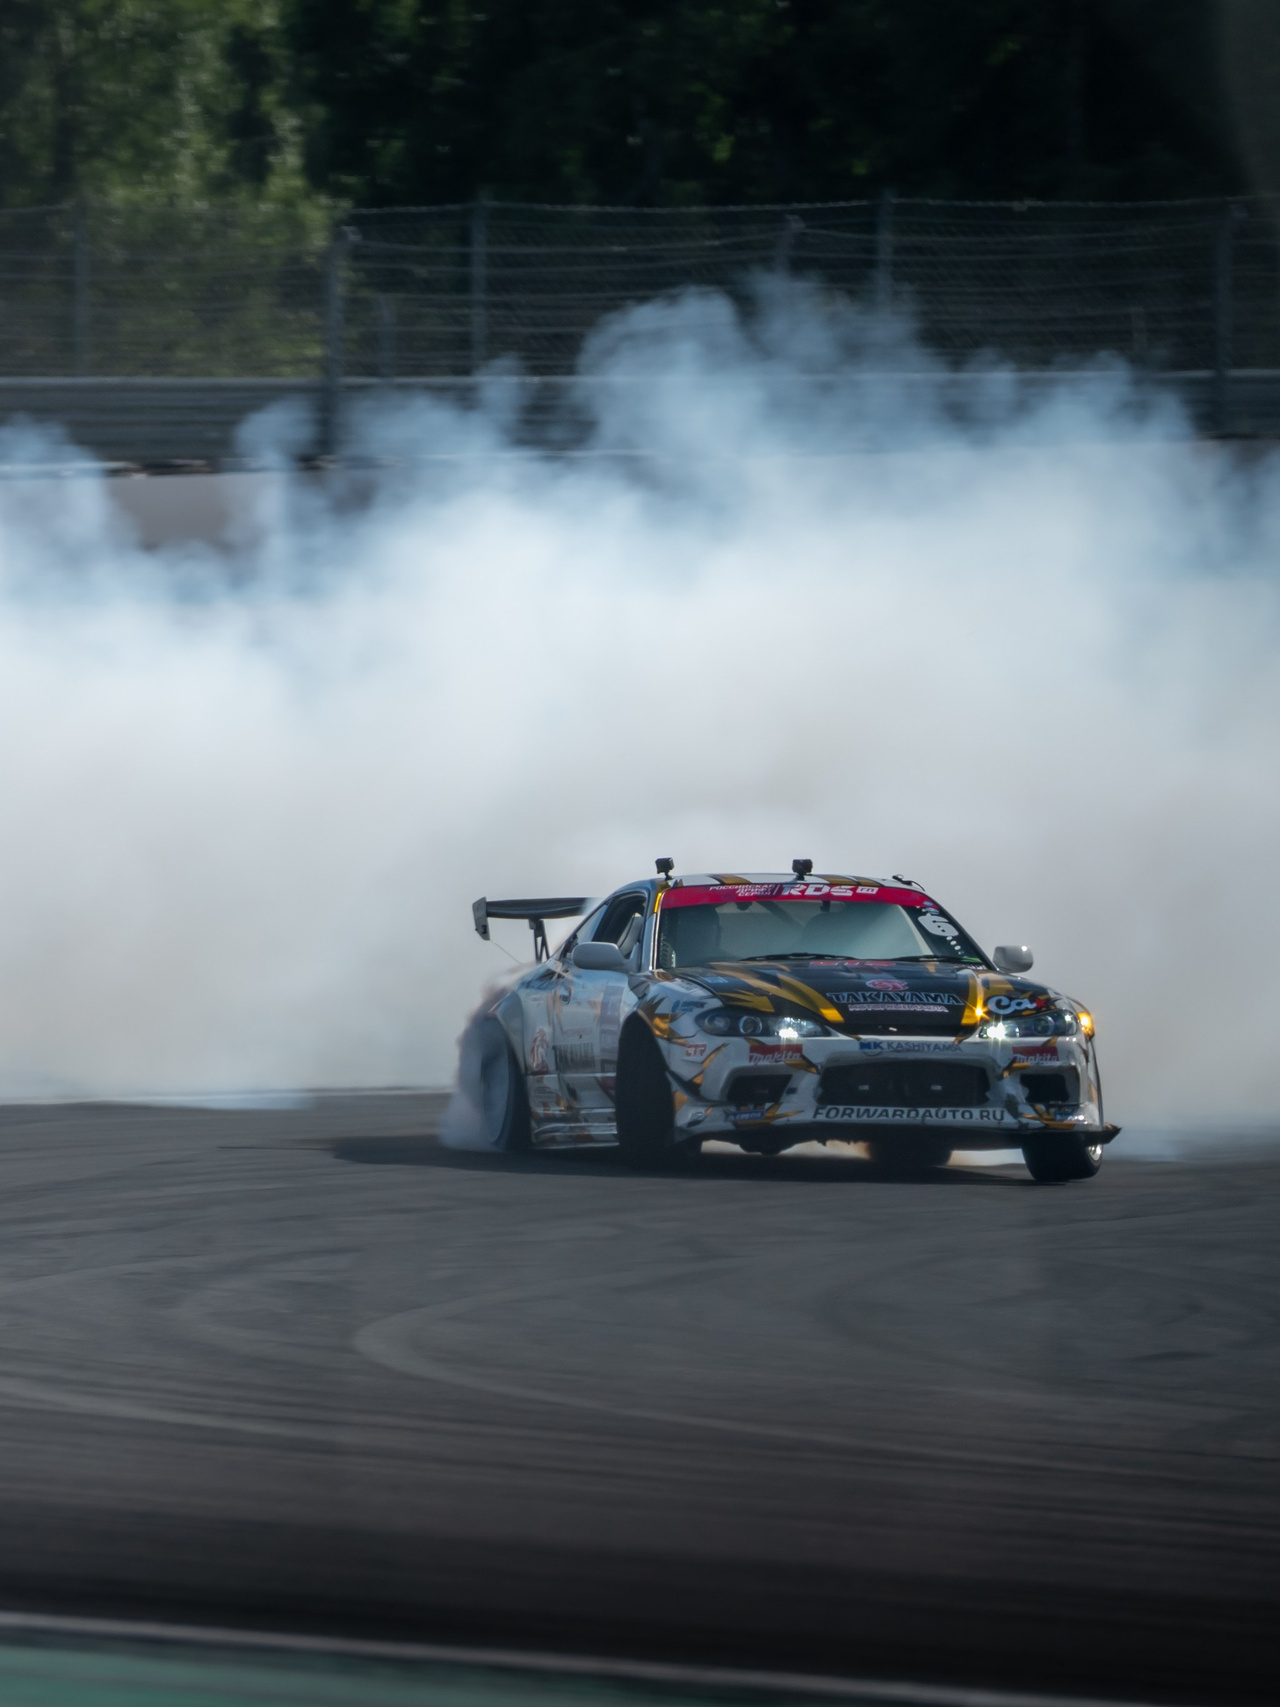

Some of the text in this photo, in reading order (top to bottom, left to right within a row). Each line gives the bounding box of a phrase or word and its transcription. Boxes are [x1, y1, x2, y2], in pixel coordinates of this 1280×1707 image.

[781, 884, 856, 896] RDS
[826, 991, 965, 1006] TAKAYAMA
[859, 1041, 963, 1052] MK KASHIYAMA
[750, 1051, 802, 1064] makita
[1013, 1053, 1059, 1063] makita
[812, 1107, 1005, 1121] FORWARDAUTO.RU
